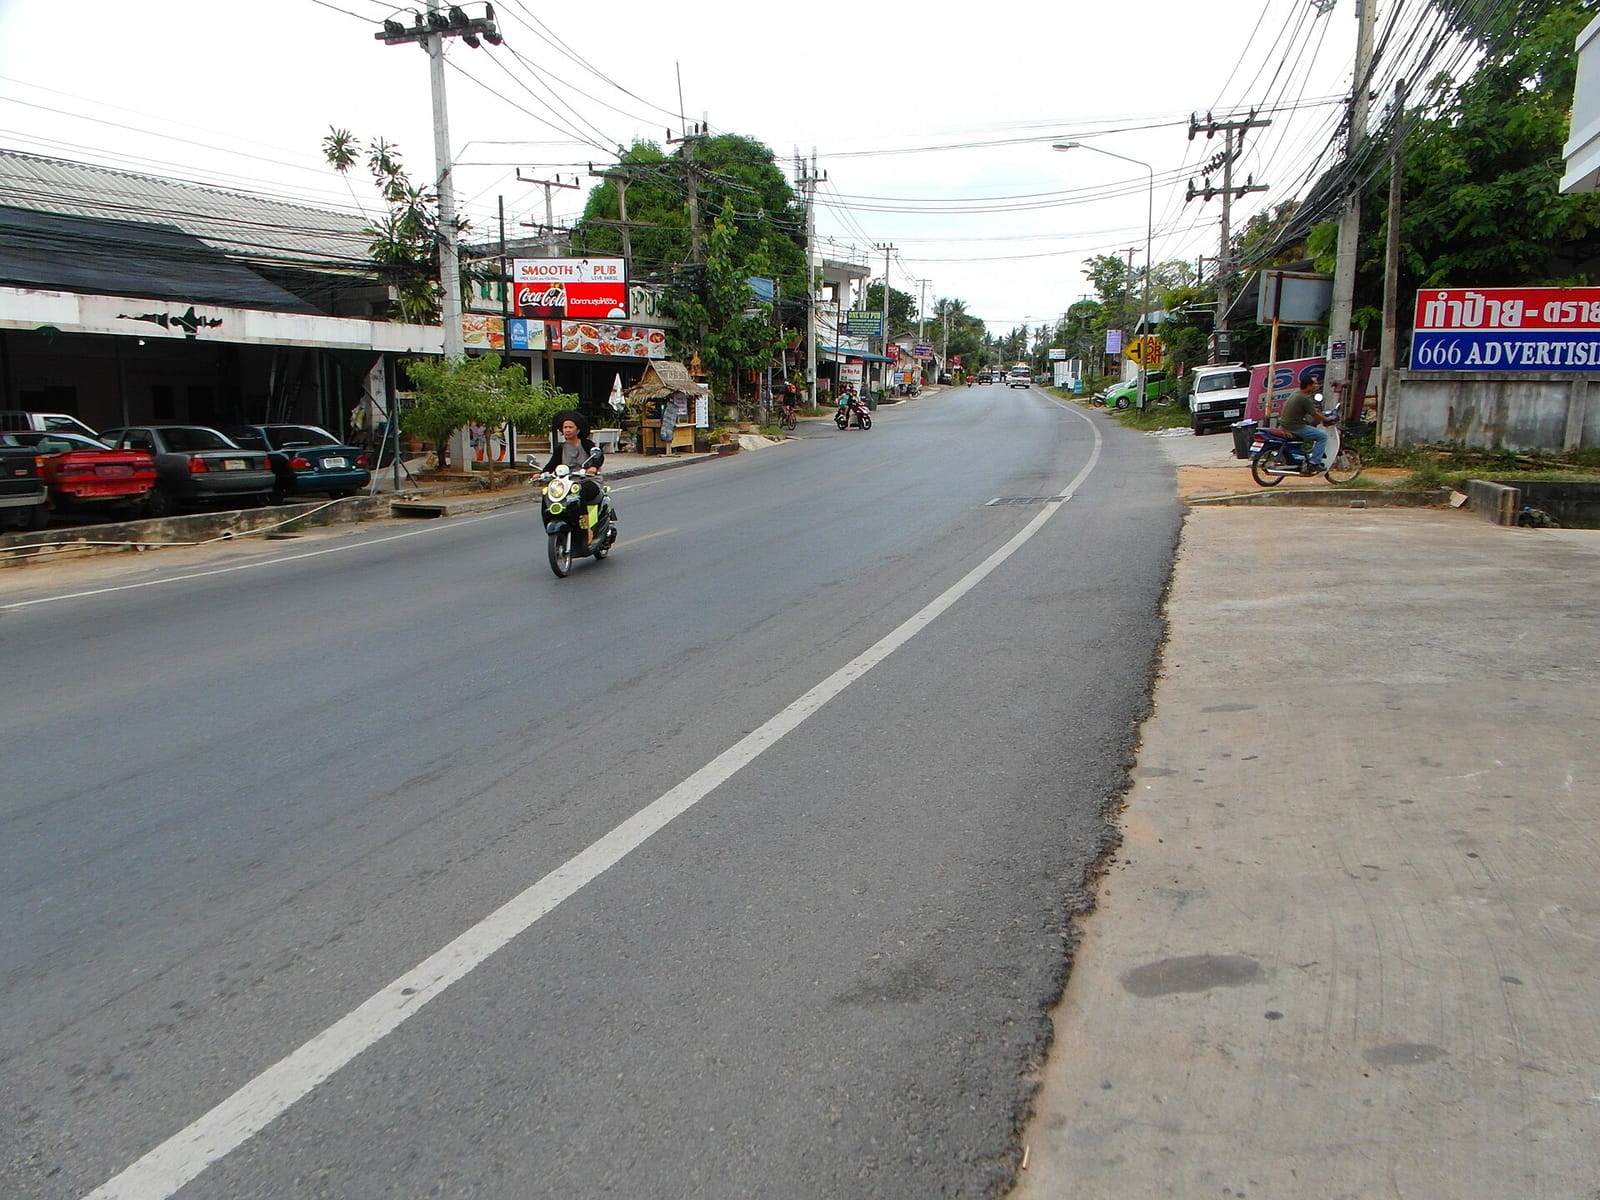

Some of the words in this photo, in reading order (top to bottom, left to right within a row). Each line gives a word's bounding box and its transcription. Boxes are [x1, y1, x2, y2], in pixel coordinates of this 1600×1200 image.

[521, 265, 573, 276] SMOOTH
[593, 265, 617, 276] PUB
[631, 286, 665, 318] PU
[1418, 338, 1461, 365] 666
[1464, 341, 1600, 365] ADVERTISI
